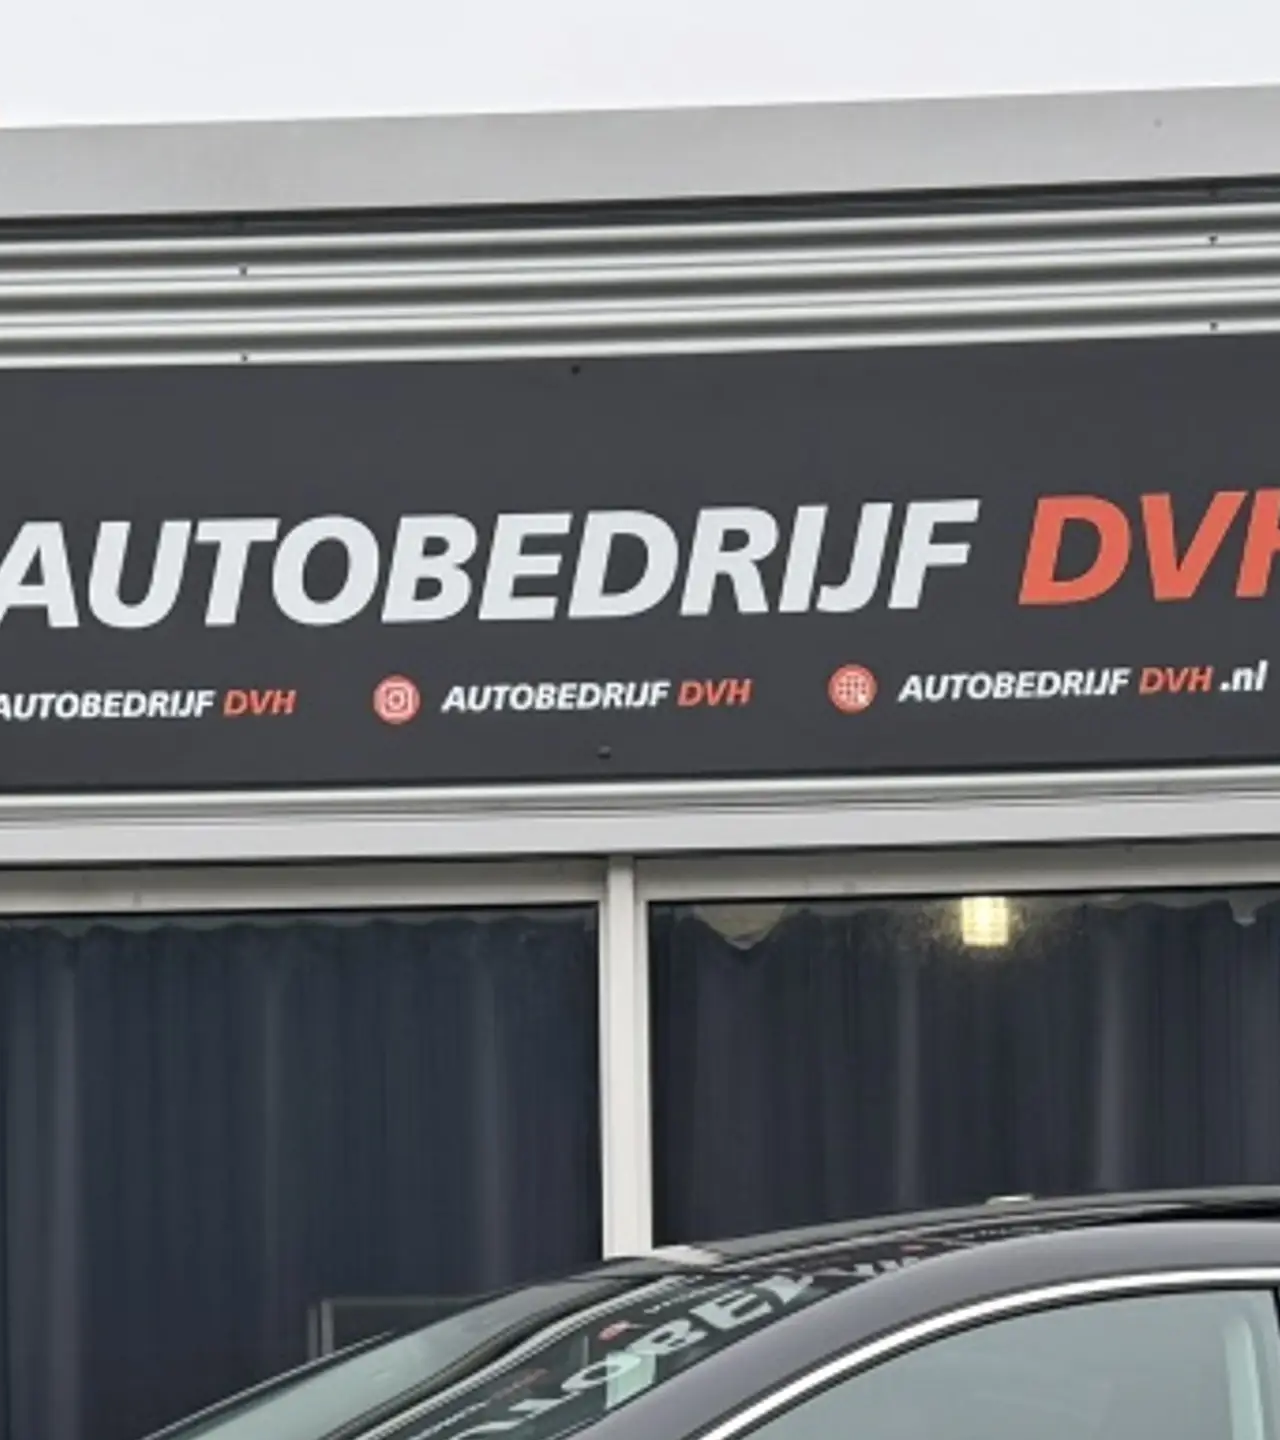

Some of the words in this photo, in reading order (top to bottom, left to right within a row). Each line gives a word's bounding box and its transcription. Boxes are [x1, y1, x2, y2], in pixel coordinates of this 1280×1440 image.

[439, 680, 672, 714] AUTOBEDRIJF
[677, 679, 753, 708] DVH
[896, 667, 1131, 703] AUTOBEDRIJF
[1138, 666, 1213, 694] DVH
[1218, 659, 1269, 692] .nl
[223, 690, 297, 717] DVH
